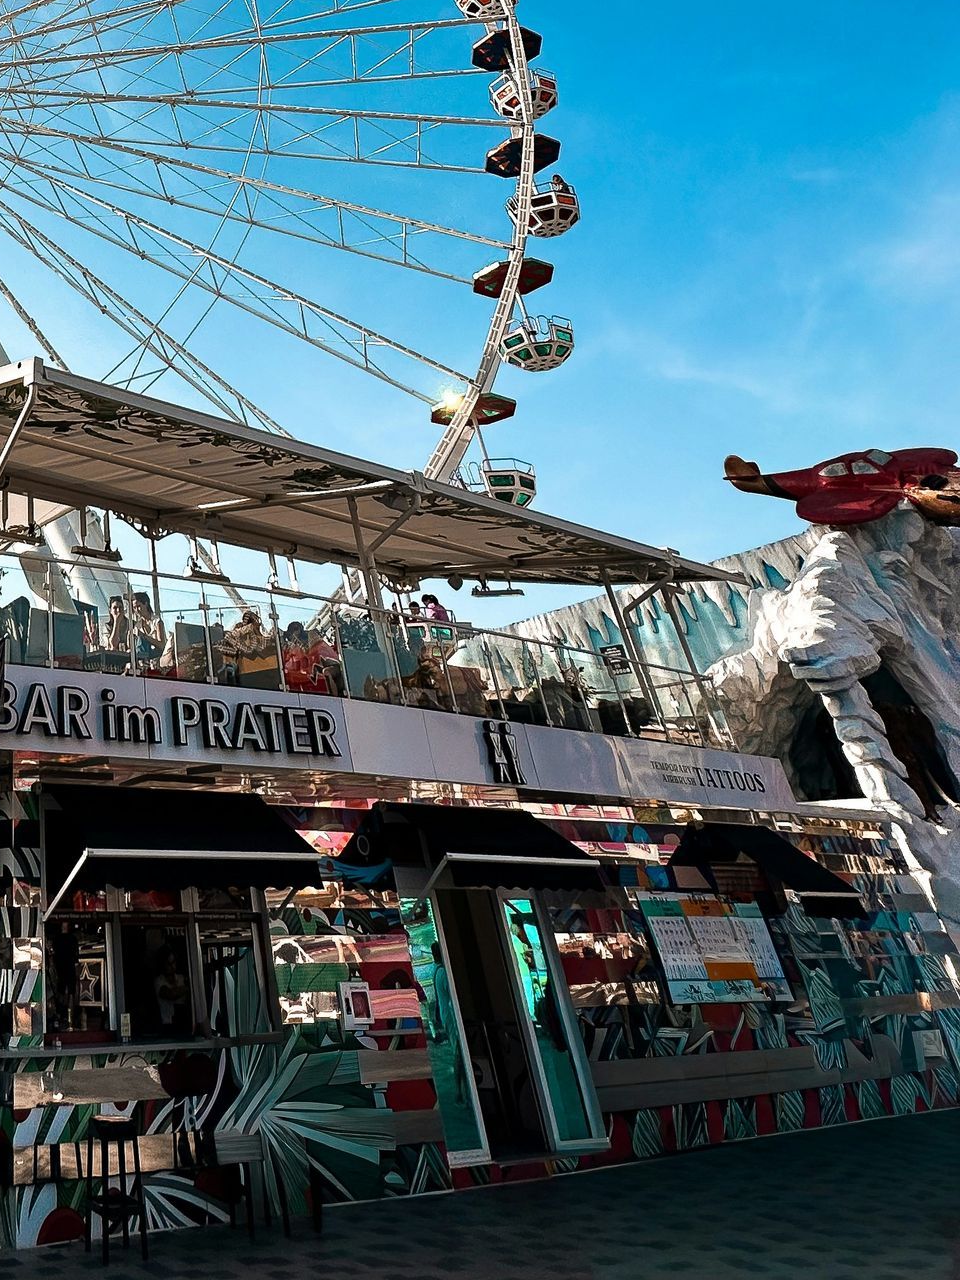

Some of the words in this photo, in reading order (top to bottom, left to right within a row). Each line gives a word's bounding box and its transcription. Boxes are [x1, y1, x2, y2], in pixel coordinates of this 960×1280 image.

[101, 688, 162, 744] im
[171, 696, 342, 757] PRATER
[650, 761, 693, 774] TEMPORARY
[662, 773, 697, 786] AIRBRUSH
[693, 766, 766, 793] TATTOOS
